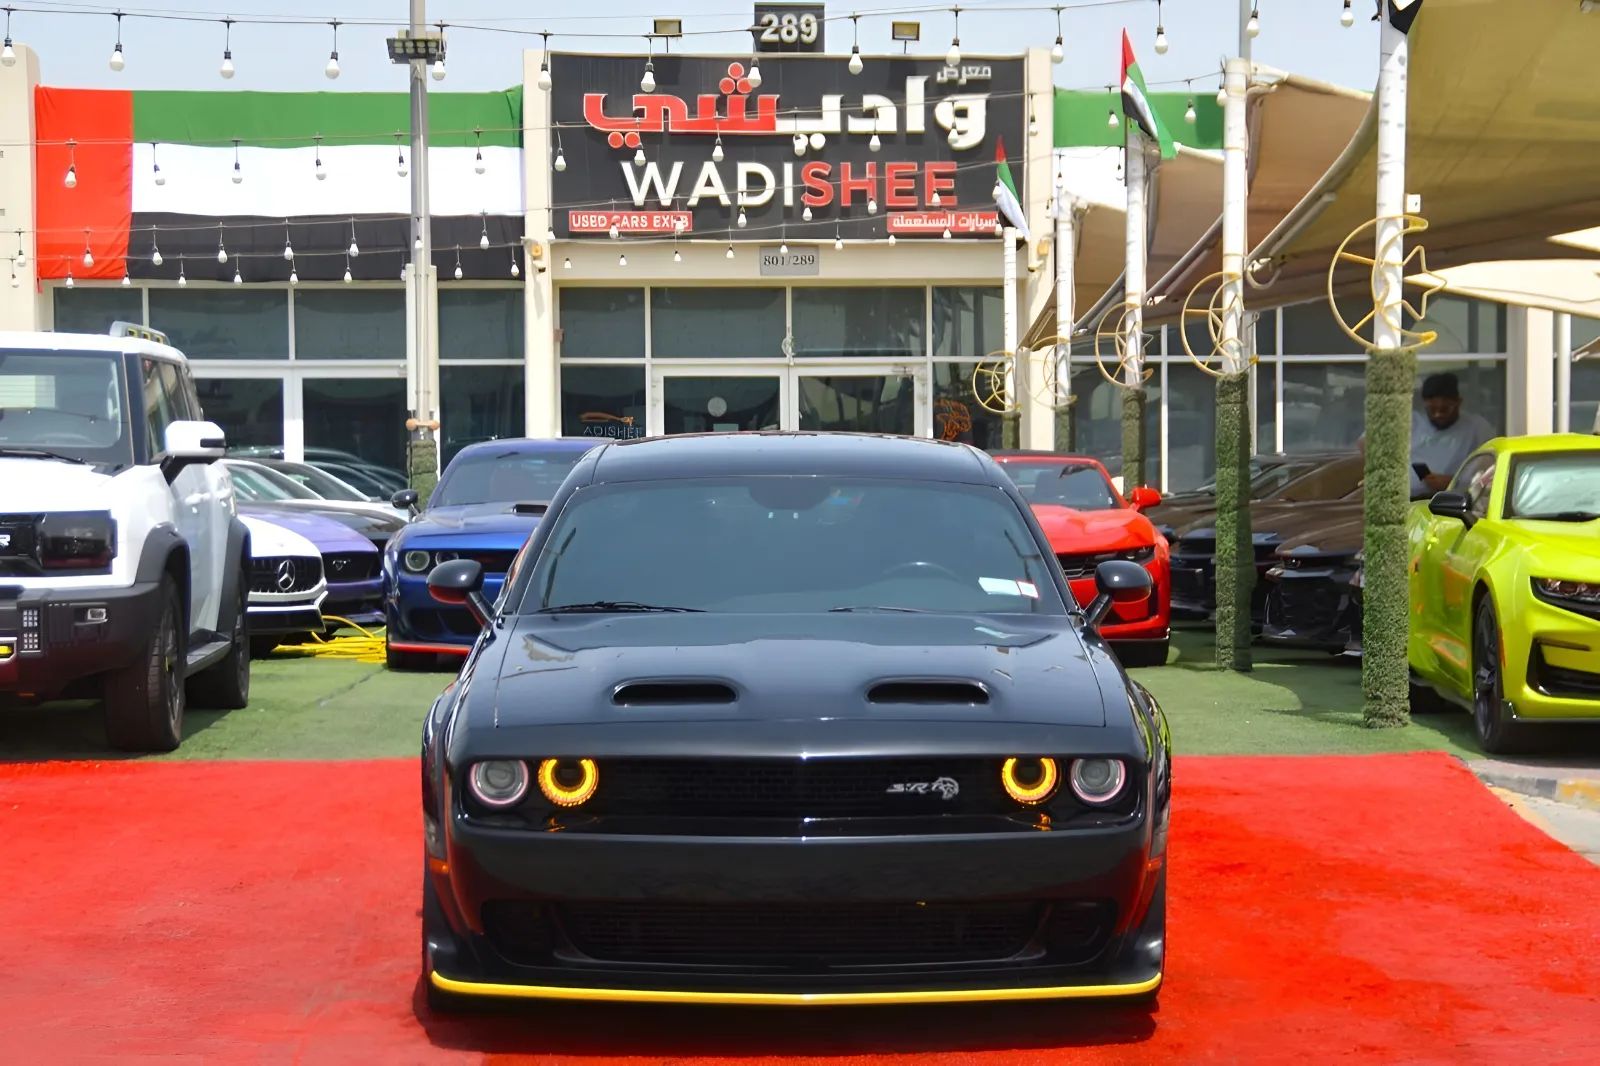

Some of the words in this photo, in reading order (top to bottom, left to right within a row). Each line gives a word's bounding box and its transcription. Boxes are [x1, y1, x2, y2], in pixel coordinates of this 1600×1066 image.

[760, 13, 818, 44] 289
[572, 214, 608, 228] USED
[611, 214, 649, 228] CARS
[653, 214, 689, 228] EXHB
[763, 255, 815, 266] 801/289
